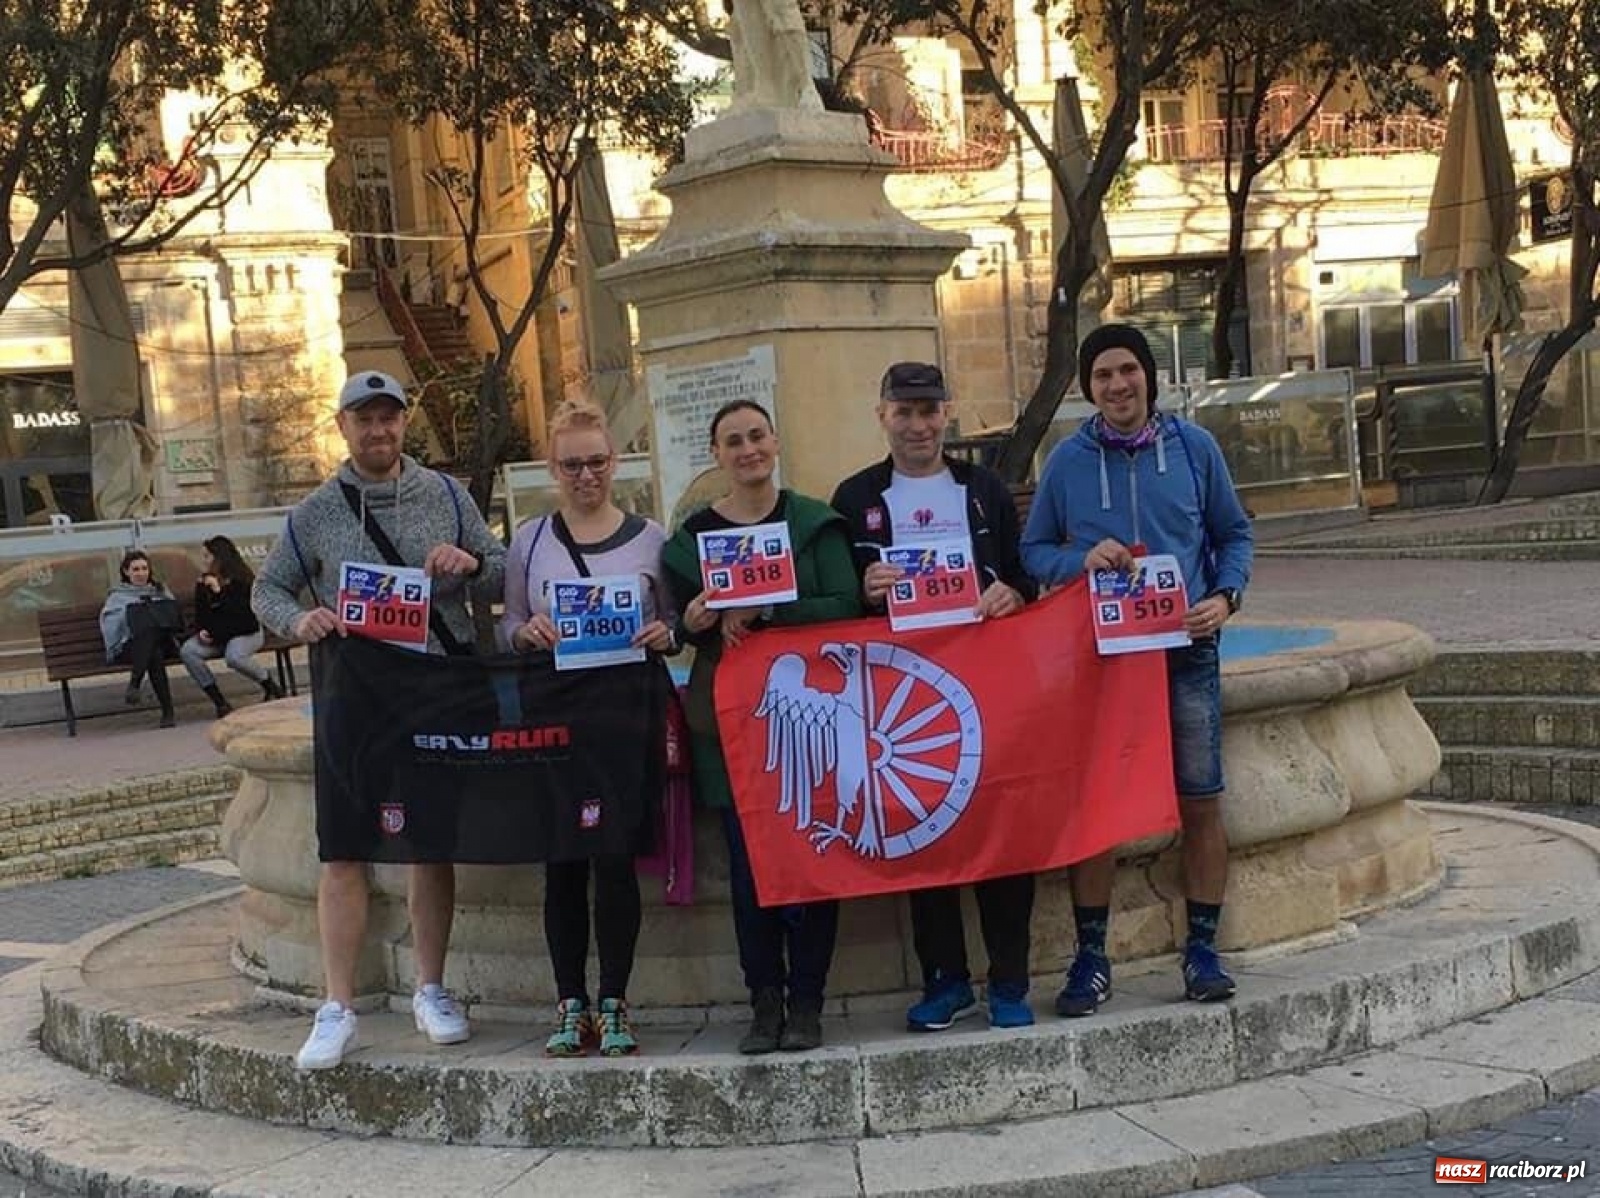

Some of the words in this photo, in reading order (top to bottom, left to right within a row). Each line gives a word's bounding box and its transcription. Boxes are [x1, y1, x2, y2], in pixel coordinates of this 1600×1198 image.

[12, 411, 80, 428] BADASS
[1239, 407, 1280, 420] BADASS
[743, 564, 781, 585] 818
[926, 576, 964, 596] 819
[371, 607, 422, 627] 1010
[1134, 597, 1174, 619] 519
[583, 617, 635, 637] 4801
